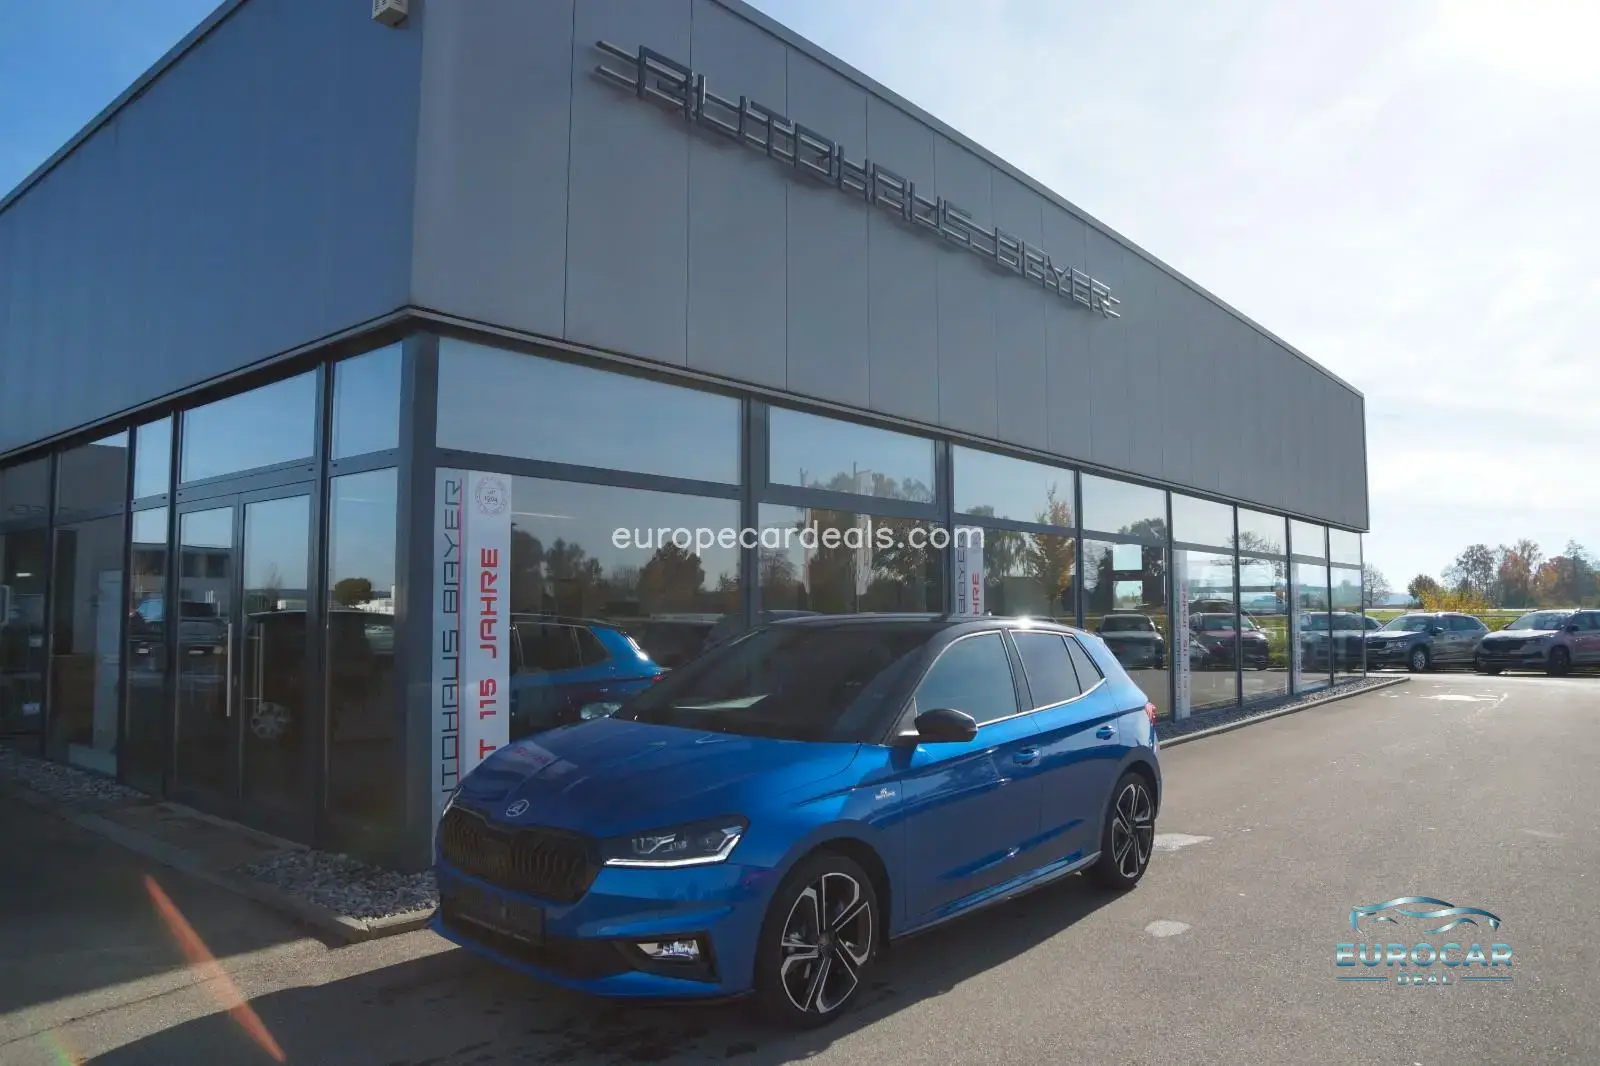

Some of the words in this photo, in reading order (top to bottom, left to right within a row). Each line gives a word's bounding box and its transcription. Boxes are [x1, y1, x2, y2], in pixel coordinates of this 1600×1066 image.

[636, 44, 974, 246] AUTOHAUS
[995, 226, 1112, 319] BAYER
[443, 479, 462, 614] BAYER
[972, 571, 981, 616] HRE
[479, 548, 499, 659] JAHRE
[479, 678, 498, 720] 115
